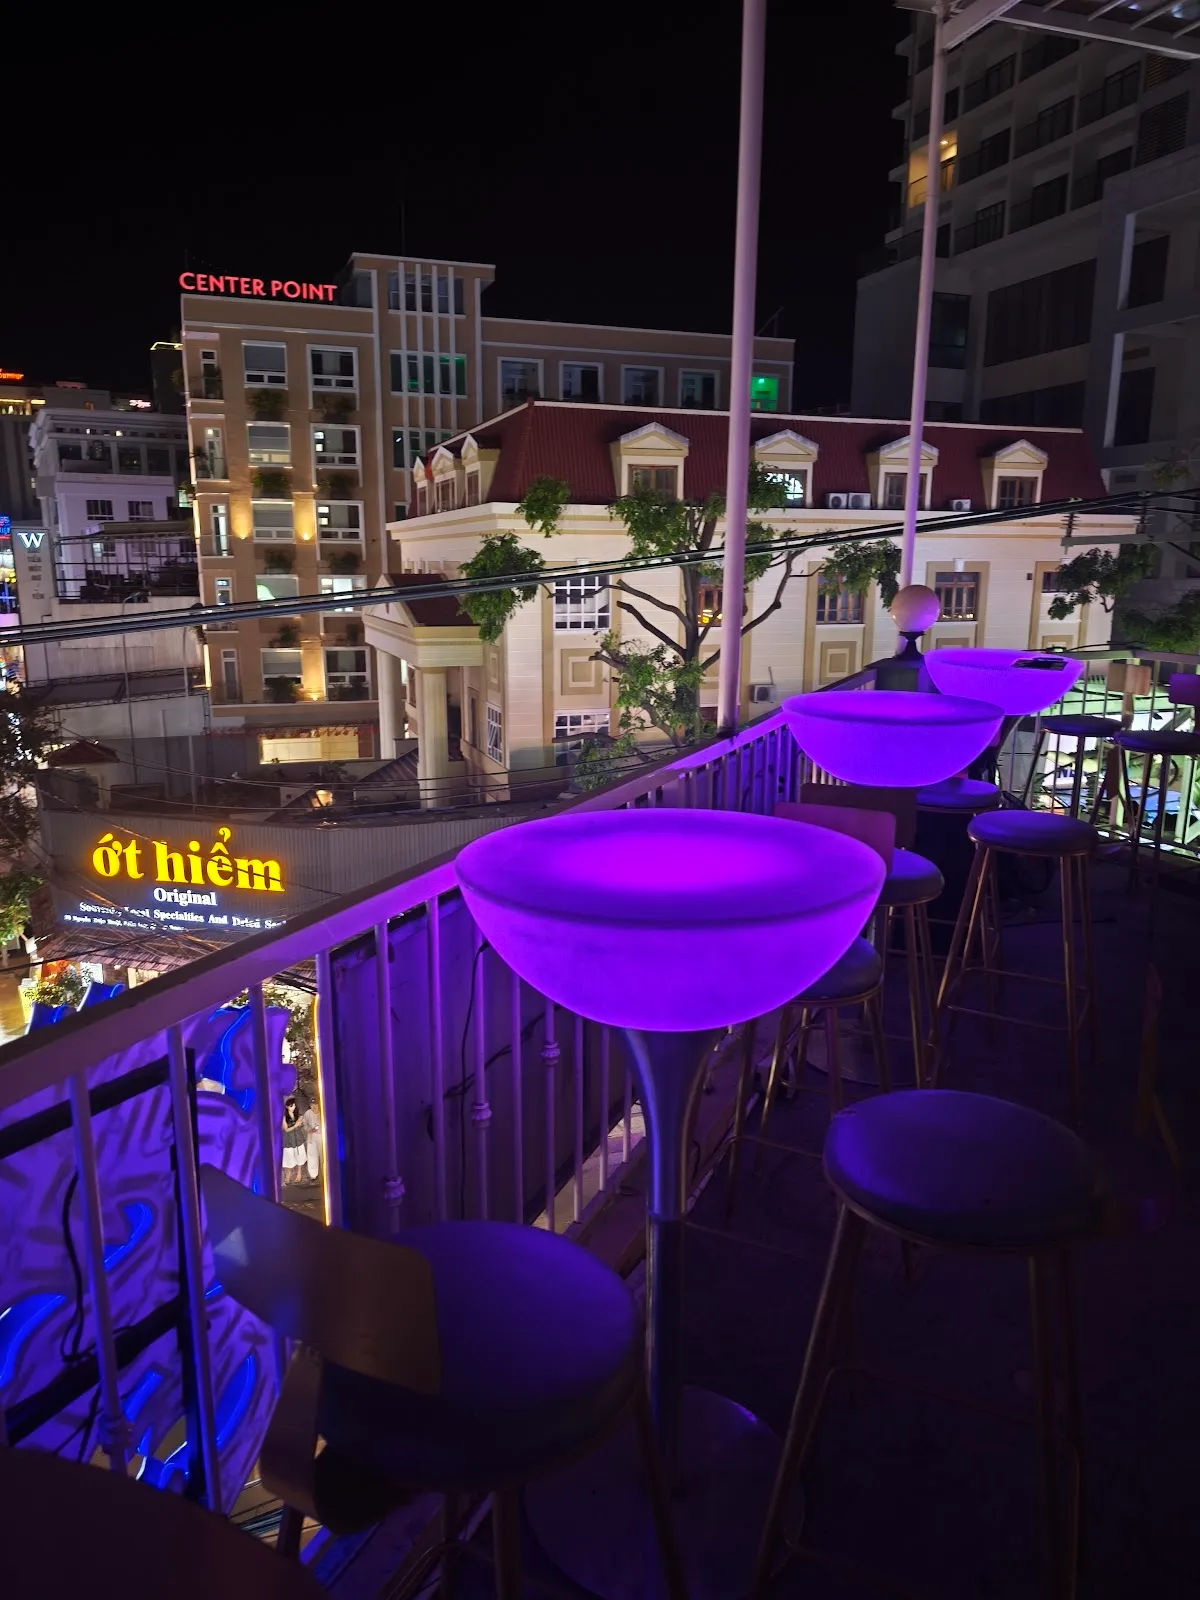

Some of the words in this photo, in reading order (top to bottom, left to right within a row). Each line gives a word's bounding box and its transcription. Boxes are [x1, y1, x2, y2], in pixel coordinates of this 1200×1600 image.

[179, 272, 266, 296] CENTER
[271, 280, 338, 302] POINT
[17, 533, 45, 549] W
[92, 833, 144, 879] ớt
[152, 827, 285, 891] hiểm
[153, 887, 217, 907] Original
[154, 909, 204, 922] Specialties
[208, 914, 228, 924] And
